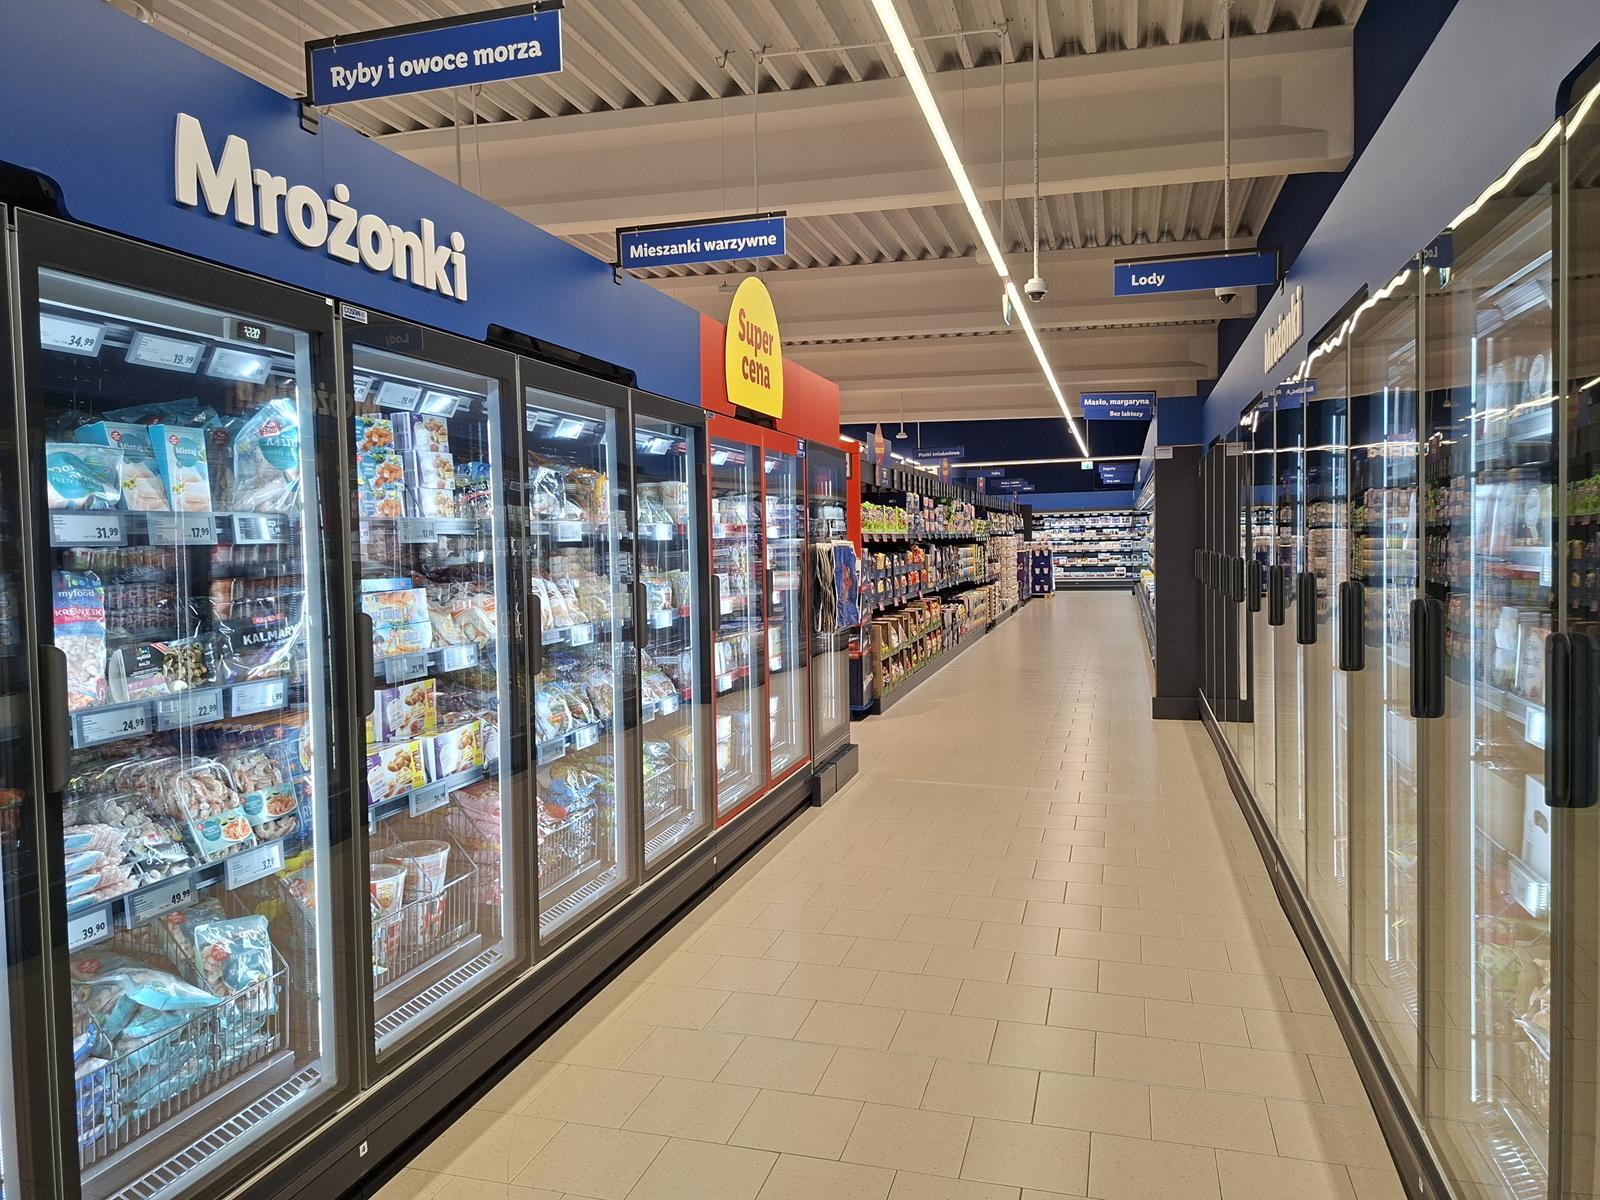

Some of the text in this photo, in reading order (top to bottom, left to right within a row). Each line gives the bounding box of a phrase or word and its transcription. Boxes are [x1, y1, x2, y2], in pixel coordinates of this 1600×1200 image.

[330, 38, 543, 91] Ryby i owoce morza
[174, 112, 469, 302] Mrożonki
[630, 234, 777, 259] Mieszanki warzywne
[1131, 273, 1165, 287] Lody
[738, 307, 774, 357] Super
[68, 335, 95, 348] 34.99
[741, 355, 771, 390] cena
[1109, 398, 1150, 407] margaryna
[175, 446, 198, 457] Mintaj
[96, 527, 119, 539] 31.99
[191, 527, 210, 539] 17.99
[58, 588, 95, 599] myfood
[171, 889, 191, 905] 49.99
[82, 922, 105, 941] 39.90
